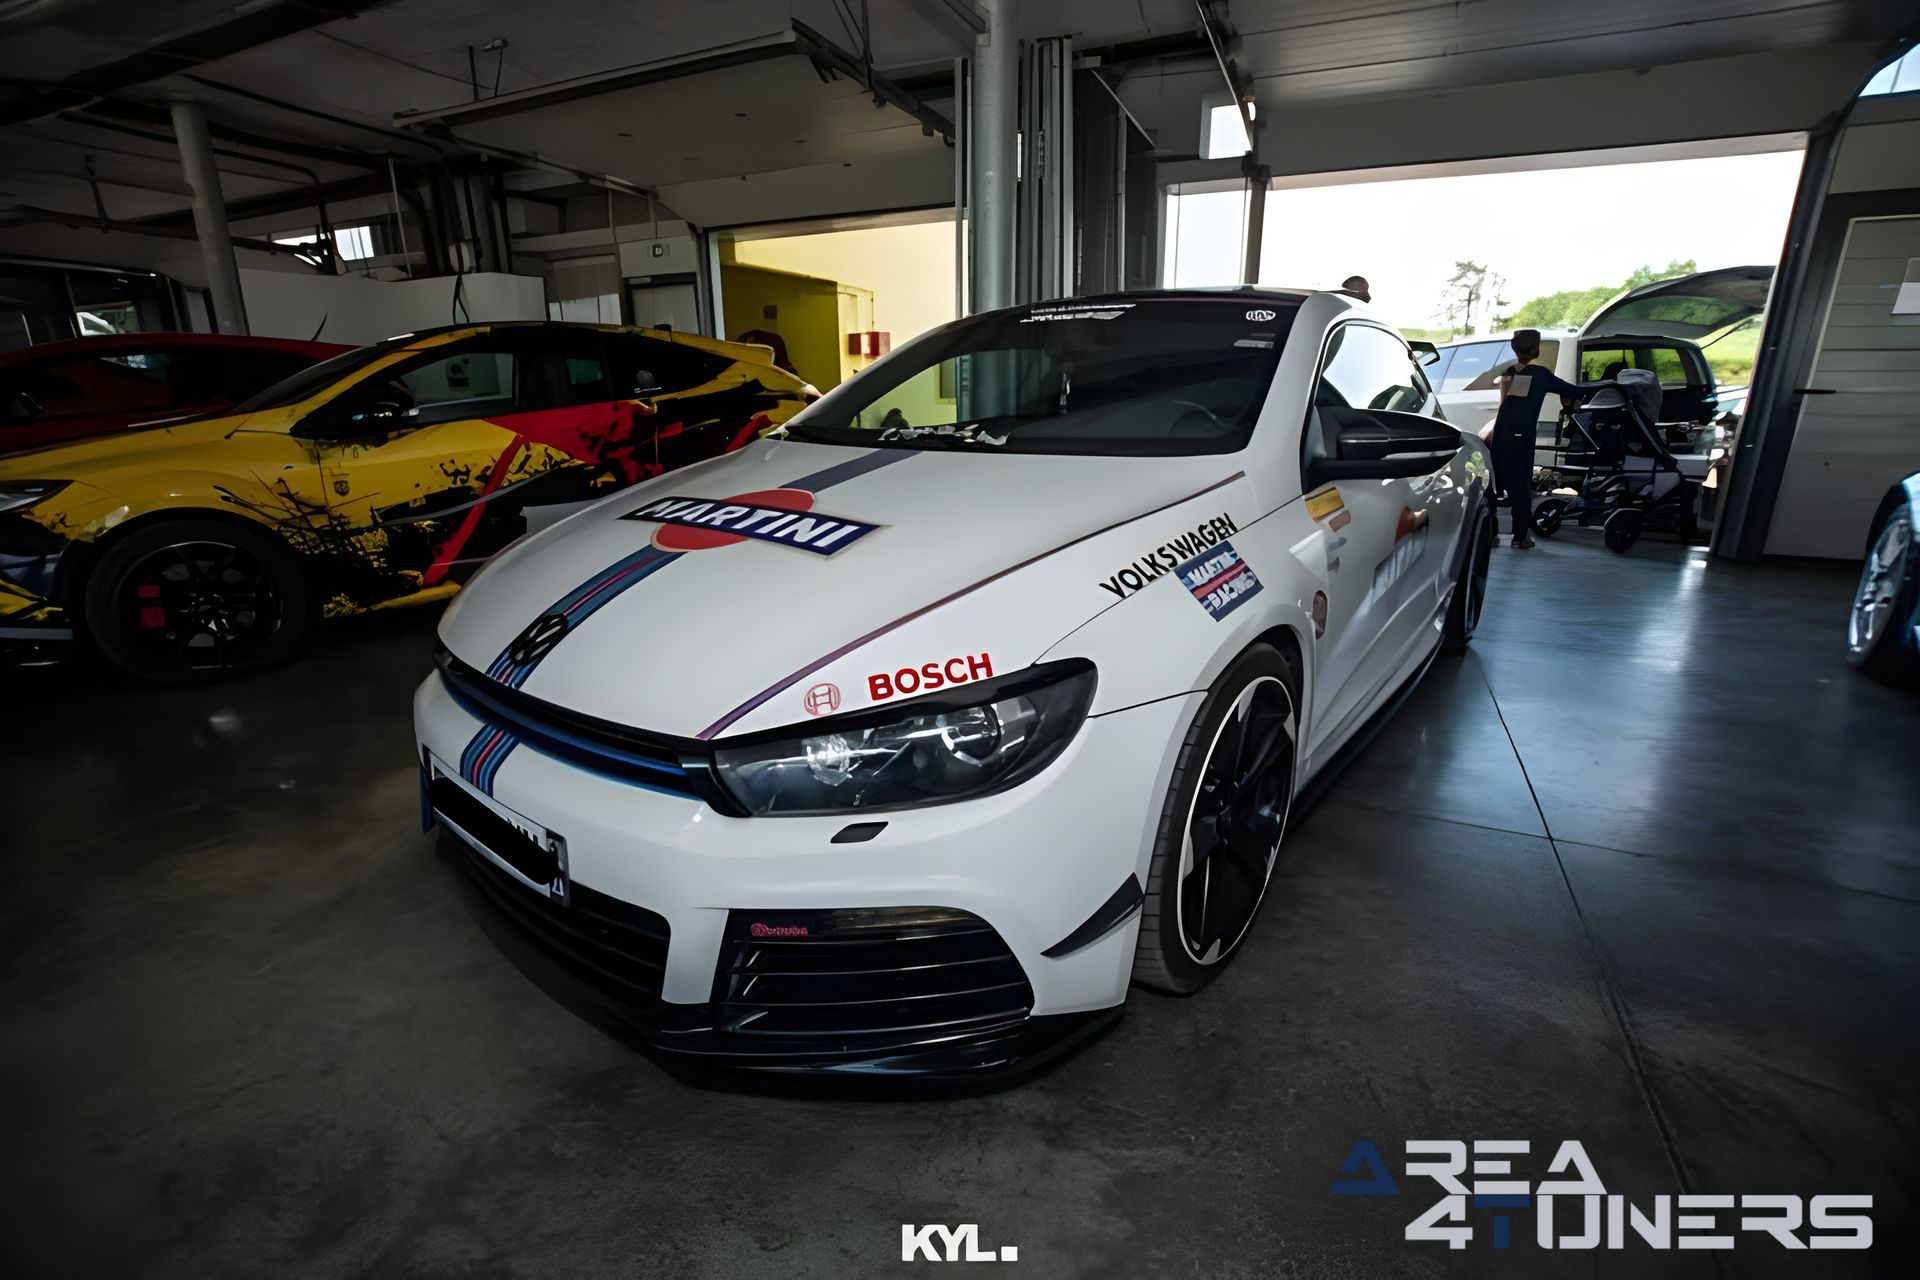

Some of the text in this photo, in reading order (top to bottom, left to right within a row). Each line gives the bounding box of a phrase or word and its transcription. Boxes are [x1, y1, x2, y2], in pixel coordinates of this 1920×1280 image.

[635, 500, 860, 548] MARTINI
[1098, 512, 1239, 599] VOLKSWAGEN
[867, 653, 994, 701] BOSCH
